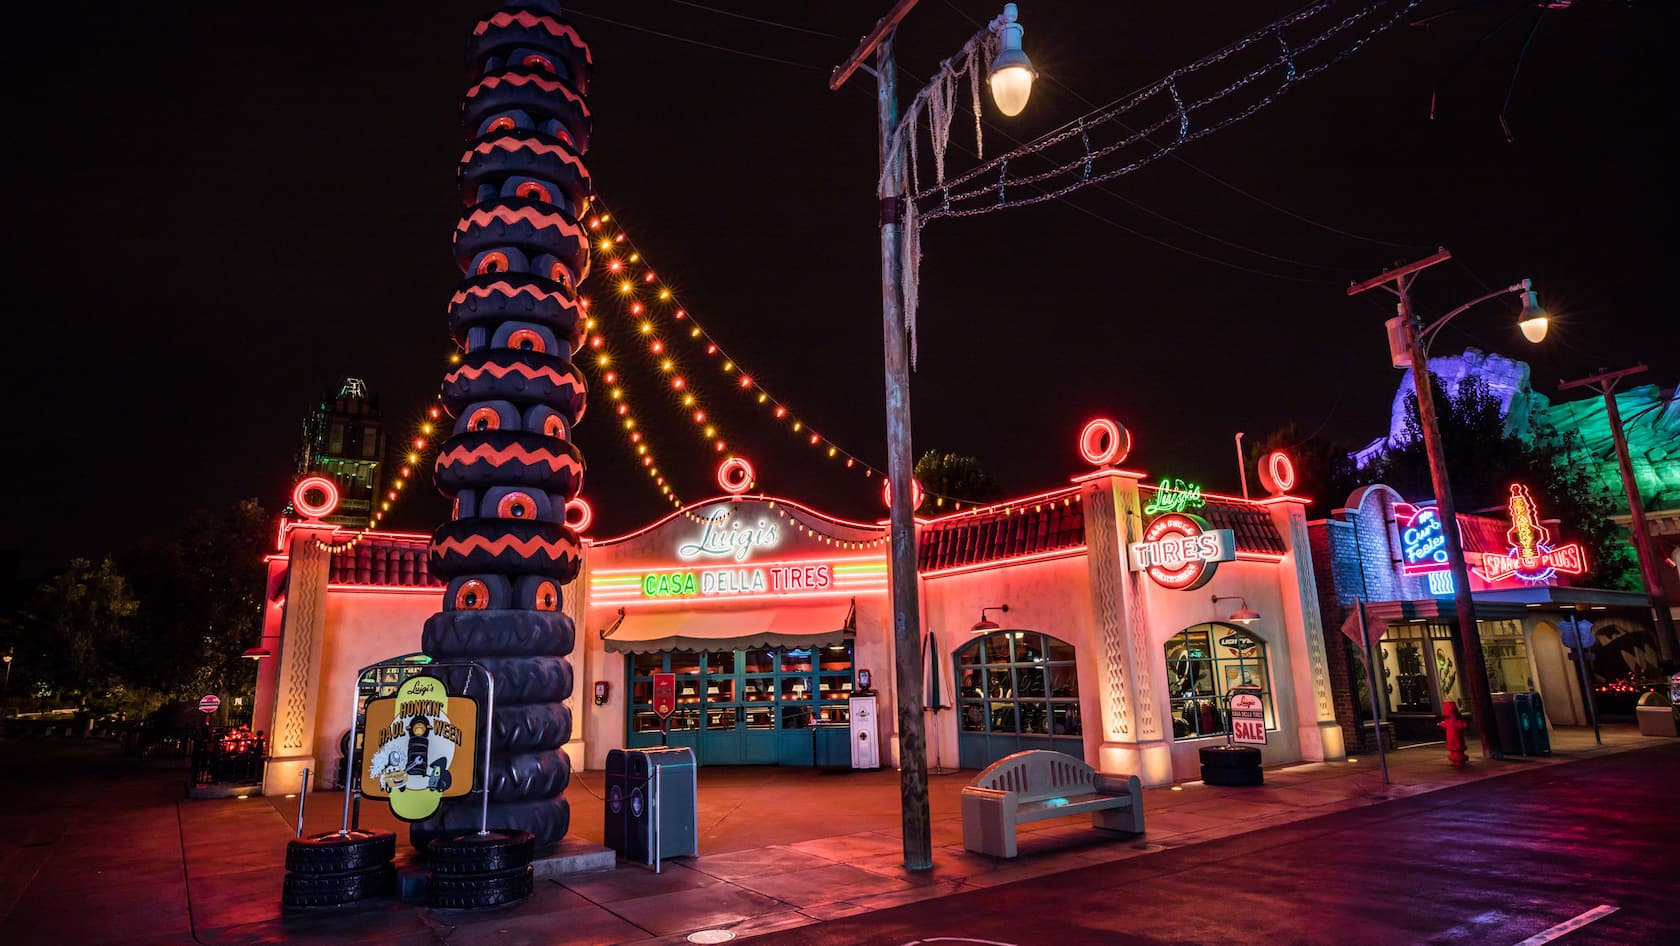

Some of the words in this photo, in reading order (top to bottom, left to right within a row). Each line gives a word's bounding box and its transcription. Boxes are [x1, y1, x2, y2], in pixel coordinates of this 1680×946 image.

[1404, 519, 1441, 547] Curb
[1133, 534, 1219, 567] TIRES
[1487, 552, 1520, 576] SPARK
[1541, 548, 1577, 570] PLUGS
[643, 573, 697, 597] CASA
[702, 569, 764, 594] DELLA
[770, 565, 830, 590] TIRES
[407, 680, 434, 696] Luigi's
[378, 722, 406, 748] HAUL
[433, 719, 462, 747] WEEN
[1235, 721, 1264, 741] SALE
